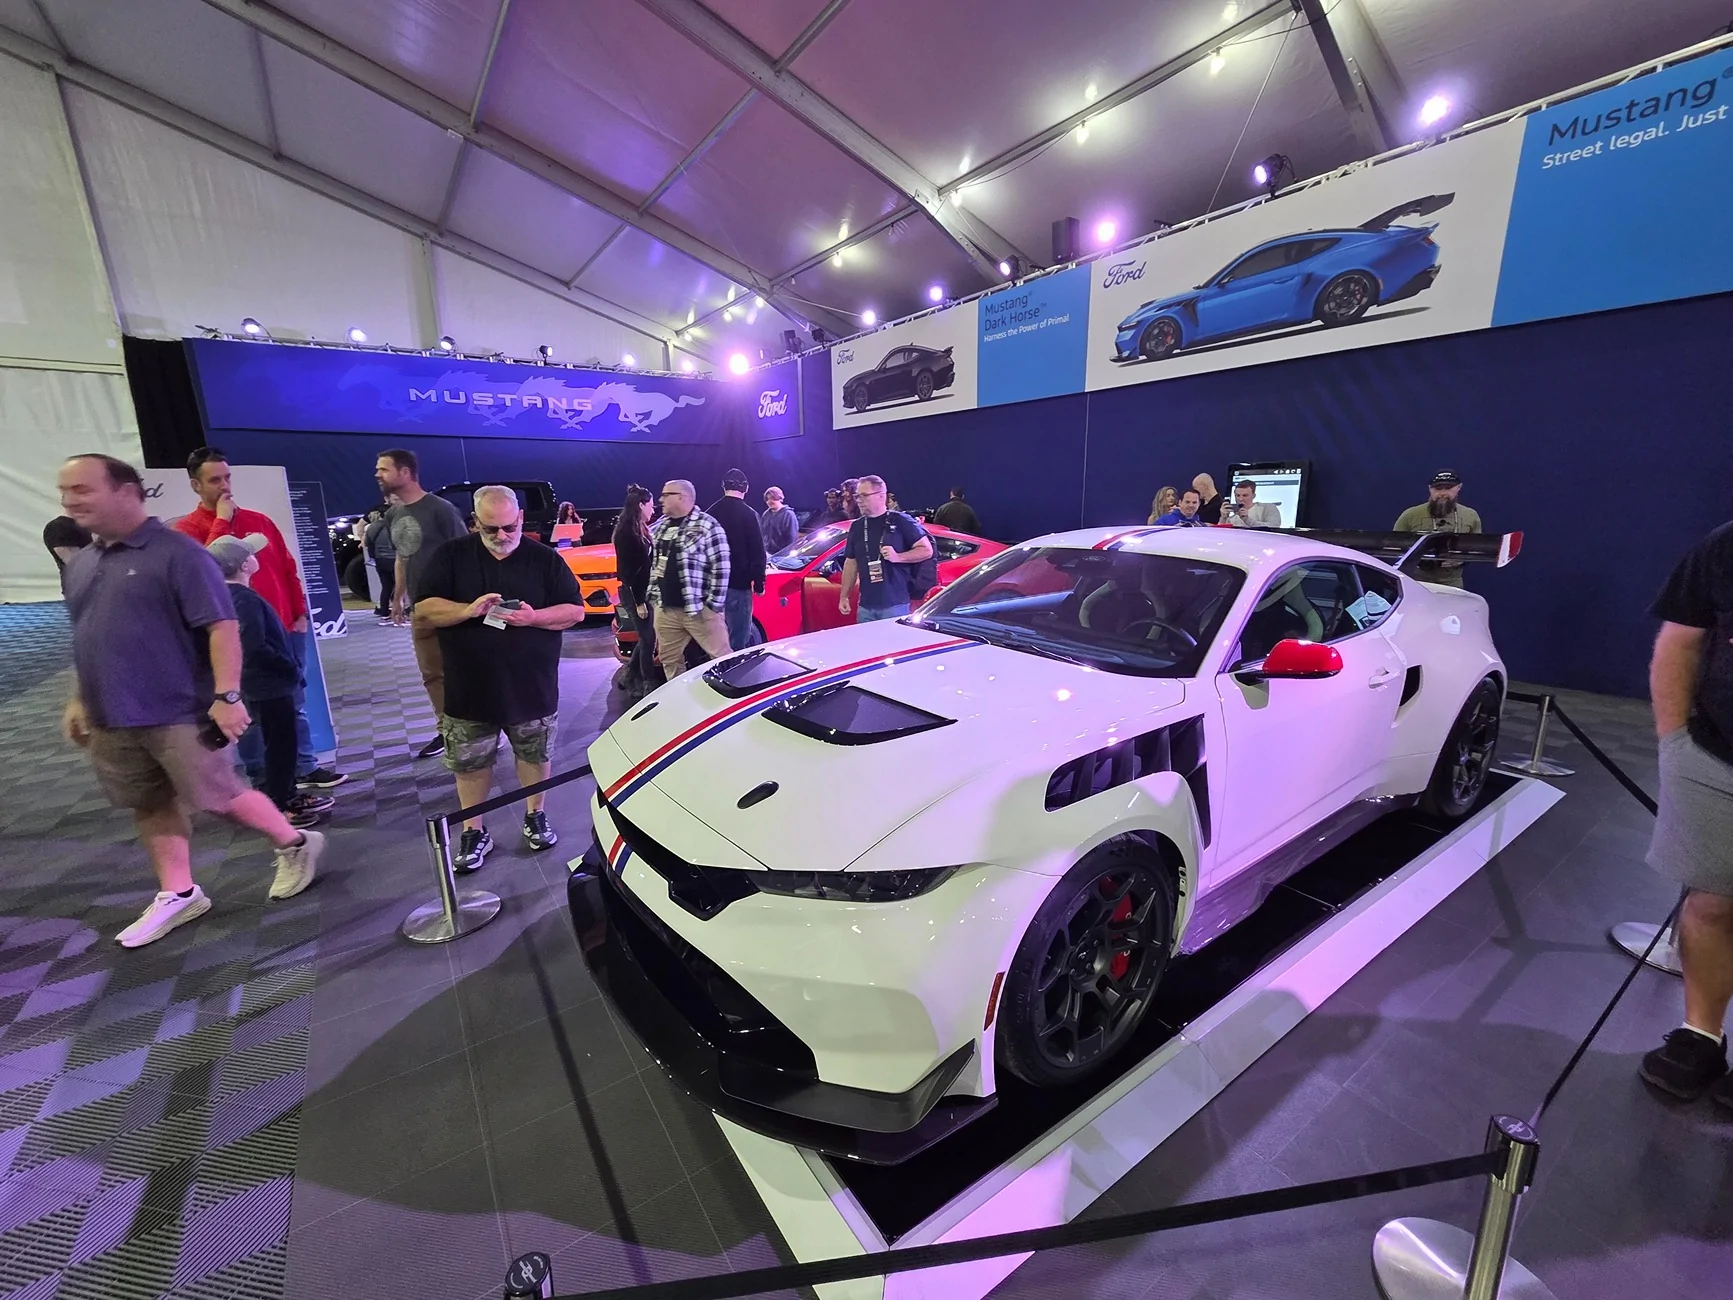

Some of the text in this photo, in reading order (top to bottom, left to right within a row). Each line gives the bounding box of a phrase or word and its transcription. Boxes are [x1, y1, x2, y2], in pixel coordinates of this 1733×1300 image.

[1542, 104, 1729, 169] Street legal. Just
[1103, 260, 1147, 288] Ford
[984, 313, 1070, 342] Harness the Power of Primal
[985, 315, 1007, 331] Dark
[837, 349, 854, 365] Ford
[409, 388, 592, 410] MUSTANG
[758, 390, 787, 418] Ford
